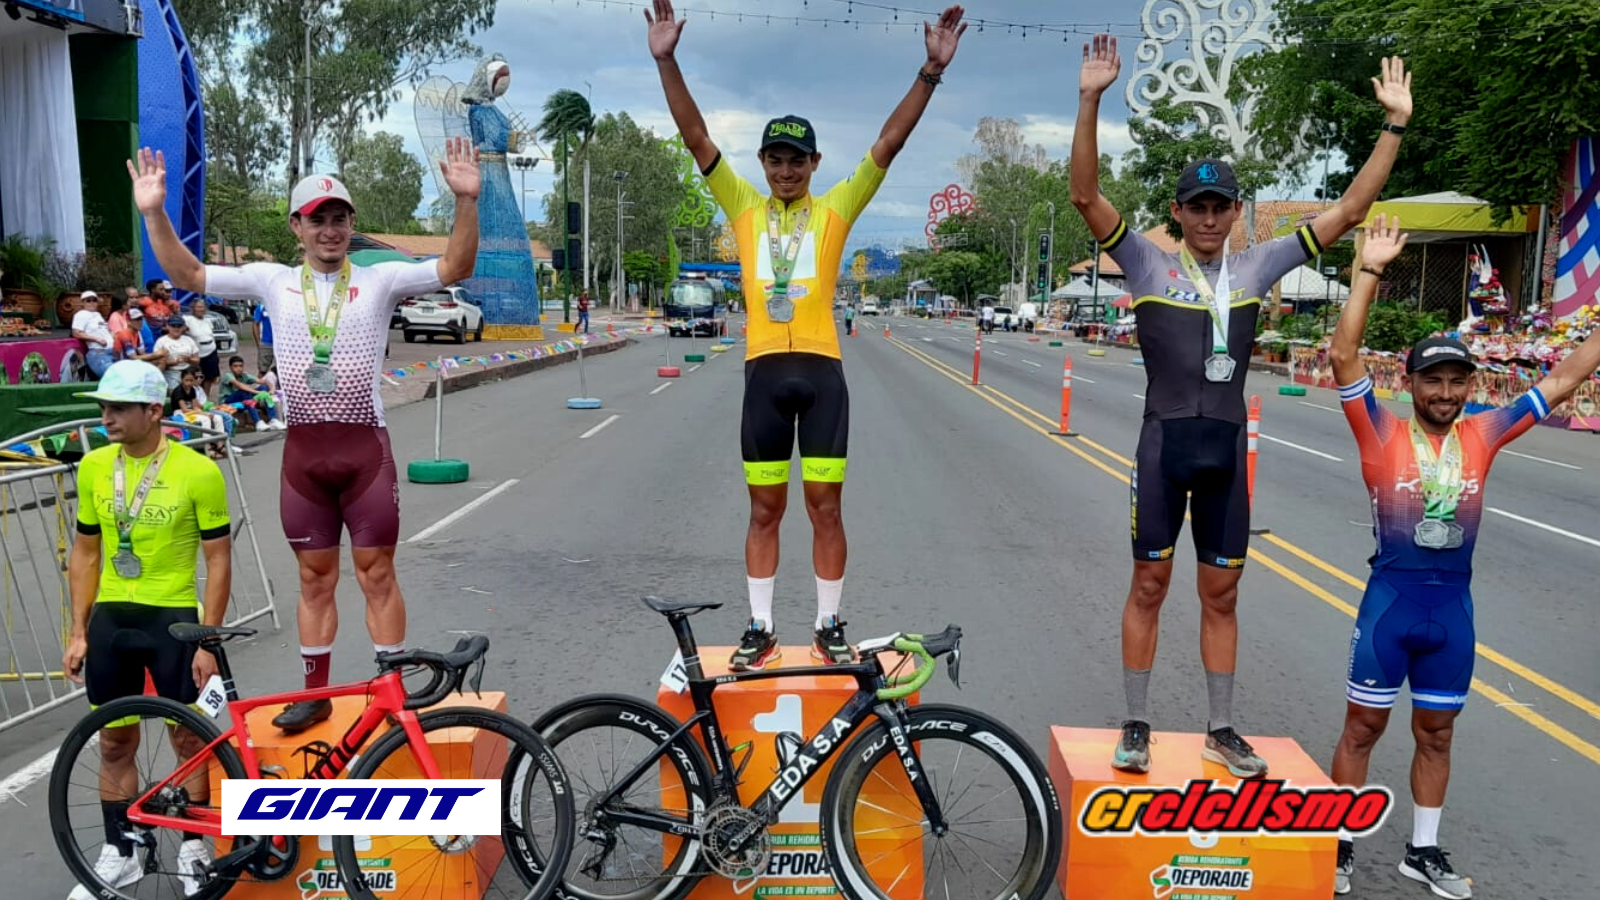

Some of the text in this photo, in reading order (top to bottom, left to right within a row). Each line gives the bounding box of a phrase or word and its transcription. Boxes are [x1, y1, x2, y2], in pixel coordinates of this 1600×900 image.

[671, 664, 688, 683] 17
[205, 689, 224, 710] 58
[770, 717, 851, 801] EDA S.A
[890, 726, 920, 782] EDA S.A
[538, 752, 565, 795] DT SWISS
[766, 853, 831, 875] EPORA
[1172, 869, 1251, 888] DEPORADE
